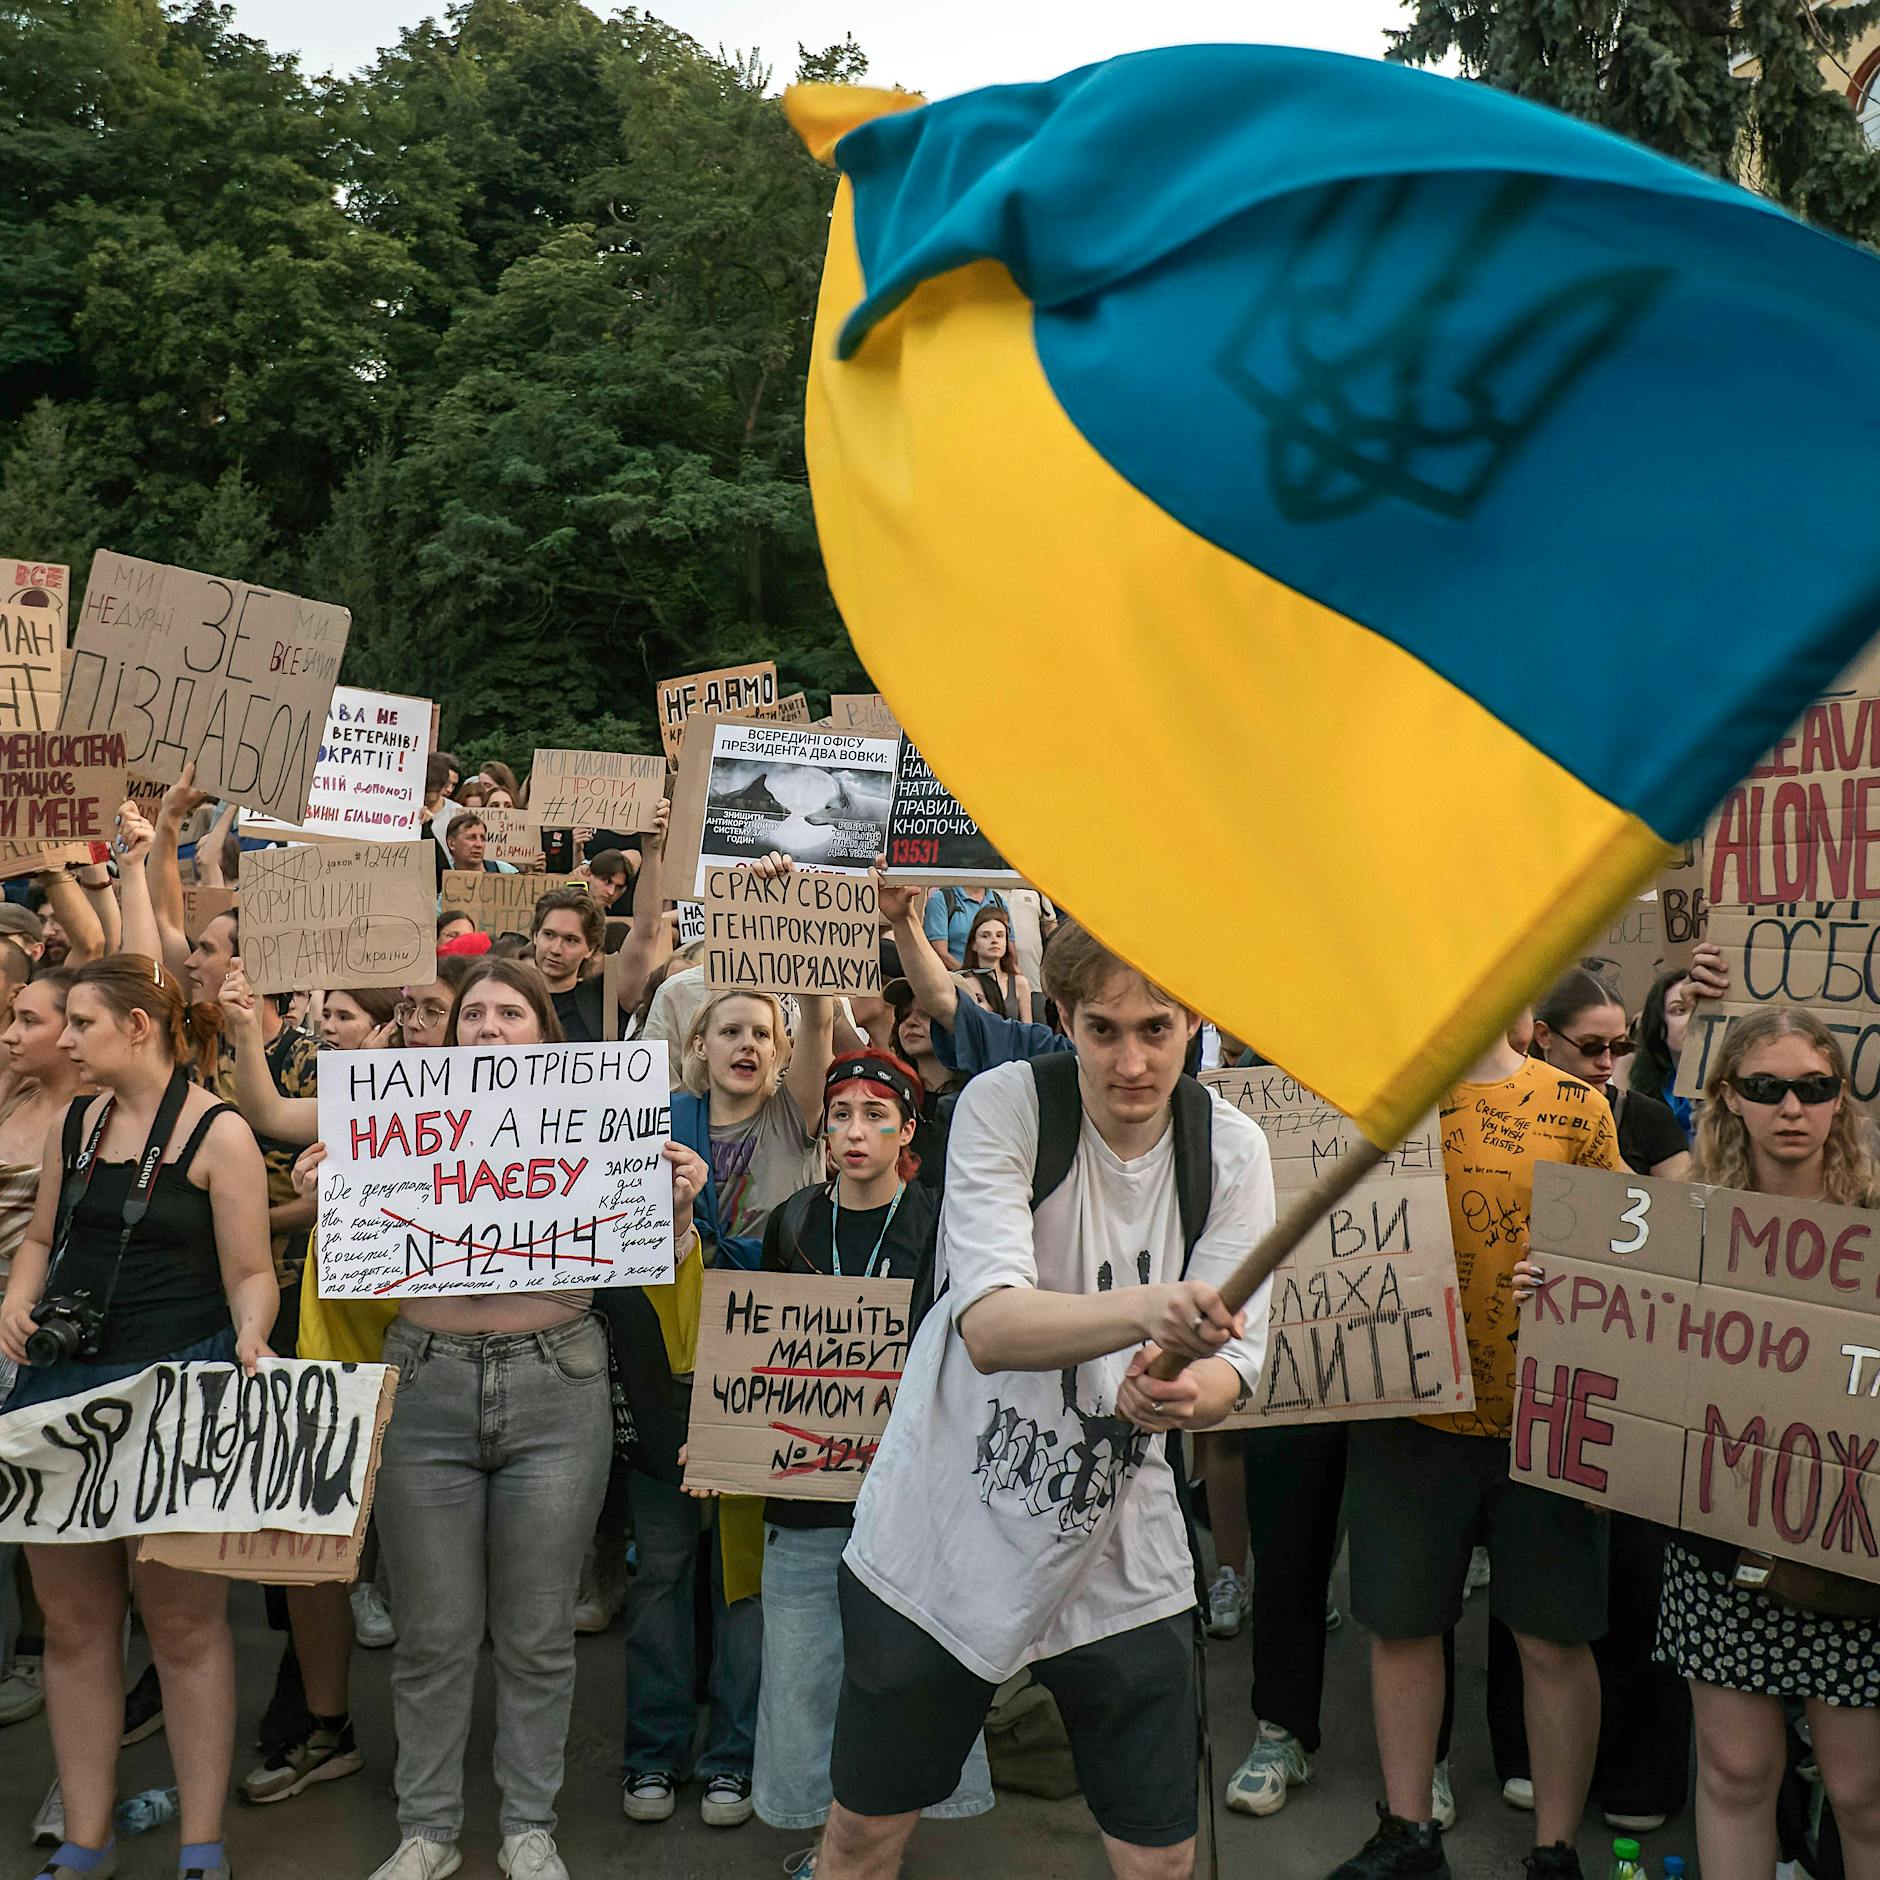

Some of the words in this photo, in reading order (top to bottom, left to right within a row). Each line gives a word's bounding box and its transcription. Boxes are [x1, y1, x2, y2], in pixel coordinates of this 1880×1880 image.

[15, 564, 65, 589] ВСЕ
[112, 563, 155, 598] МИ
[185, 580, 271, 683] ЗЕ
[269, 640, 303, 675] ВСЕ
[376, 707, 399, 726] НЕ
[664, 683, 698, 727] НЕ
[703, 671, 777, 717] ДАМО
[57, 650, 312, 821] ПІЗДАБОЛ
[332, 726, 420, 752] ВЕТЕРАНІВ!
[721, 739, 807, 758] ПРЕЗИДЕНТА
[809, 748, 839, 761] ДВА
[840, 749, 888, 764] ВОВКИ:
[748, 729, 821, 746] ВСЕРЕДИНІ
[823, 735, 865, 749] ОФІСУ
[559, 776, 637, 799] ПРОТИ
[28, 797, 102, 838] МЕНЕ
[344, 809, 416, 830] БІЛЬШОГО!
[713, 825, 752, 838] СИСТЕМУ
[752, 829, 763, 838] ЗА
[723, 810, 765, 822] ЗНИЩИТИ
[893, 819, 979, 836] КНОПОЧКУ
[726, 834, 755, 845] ГОДИН
[892, 839, 940, 865] 13531
[1709, 777, 1880, 905] ALONE
[242, 880, 372, 928] КОРУПЦІЙНІ
[709, 870, 793, 905] СРАКУ
[797, 872, 876, 914] СВОЮ
[712, 913, 876, 949] ГЕНПРОКУРОРУ
[243, 929, 345, 985] ОРГАНИ
[709, 948, 882, 991] ПІДПОРЯДКУЙ
[350, 1058, 451, 1102] НАМ
[471, 1048, 652, 1093] ПОТРІБНО
[490, 1107, 520, 1148] А
[540, 1107, 588, 1145] НЕ
[599, 1106, 671, 1143] ВАШЕ
[1475, 1098, 1513, 1123] CREATE
[1513, 1117, 1532, 1131] THE
[1536, 1113, 1569, 1126] NYC
[1482, 1132, 1525, 1155] EXISTED
[1501, 1125, 1525, 1142] WISH
[137, 1146, 161, 1189] Canon
[433, 1156, 589, 1205] НАЄБУ
[604, 1153, 660, 1177] ЗАКОН
[324, 1173, 352, 1202] Де
[321, 1207, 343, 1228] На
[633, 1204, 657, 1217] НЕ
[1329, 1198, 1411, 1258] ВИ
[1727, 1205, 1880, 1299] МОЄ
[525, 1277, 545, 1288] не
[1268, 1262, 1406, 1324] ЛЯХА
[1534, 1272, 1810, 1374] КРАЇНОЮ
[713, 1374, 864, 1419] ЧОРНИЛОМ
[1515, 1356, 1619, 1494] НЕ
